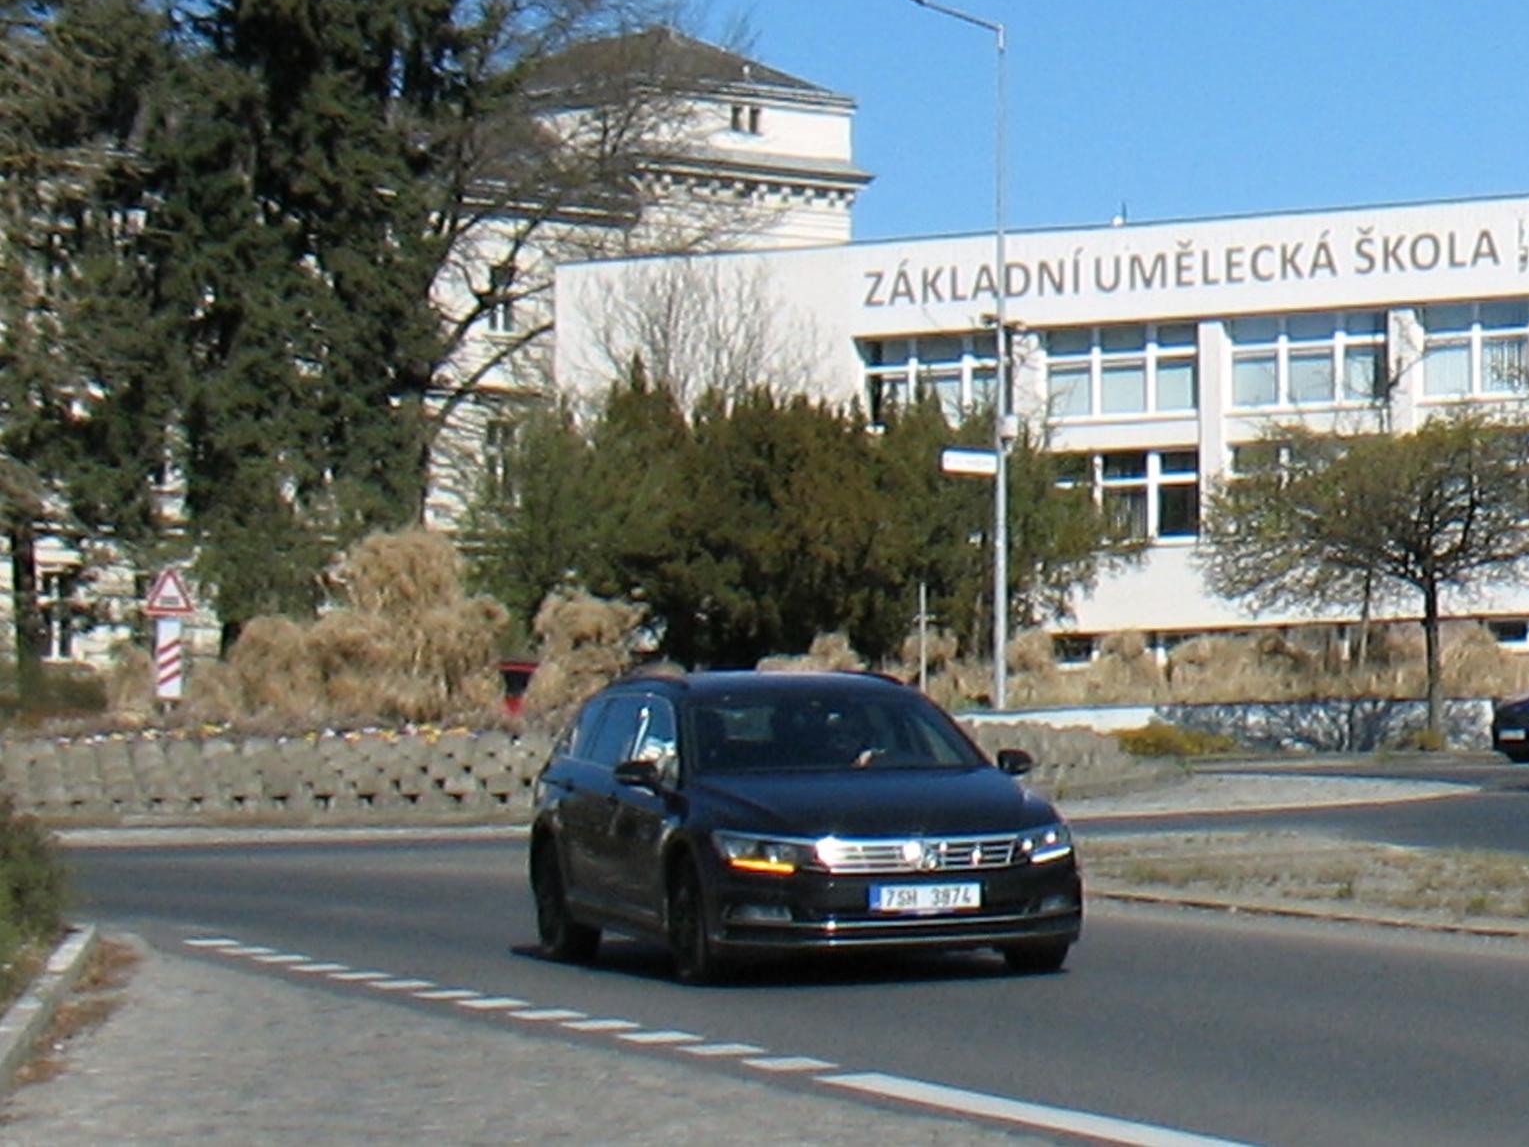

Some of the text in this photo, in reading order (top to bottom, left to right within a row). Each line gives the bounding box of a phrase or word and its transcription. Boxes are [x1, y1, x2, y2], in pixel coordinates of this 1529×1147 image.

[863, 225, 1502, 307] ZÁKLADNÍ UMĚLECKÁ ŠKOLA
